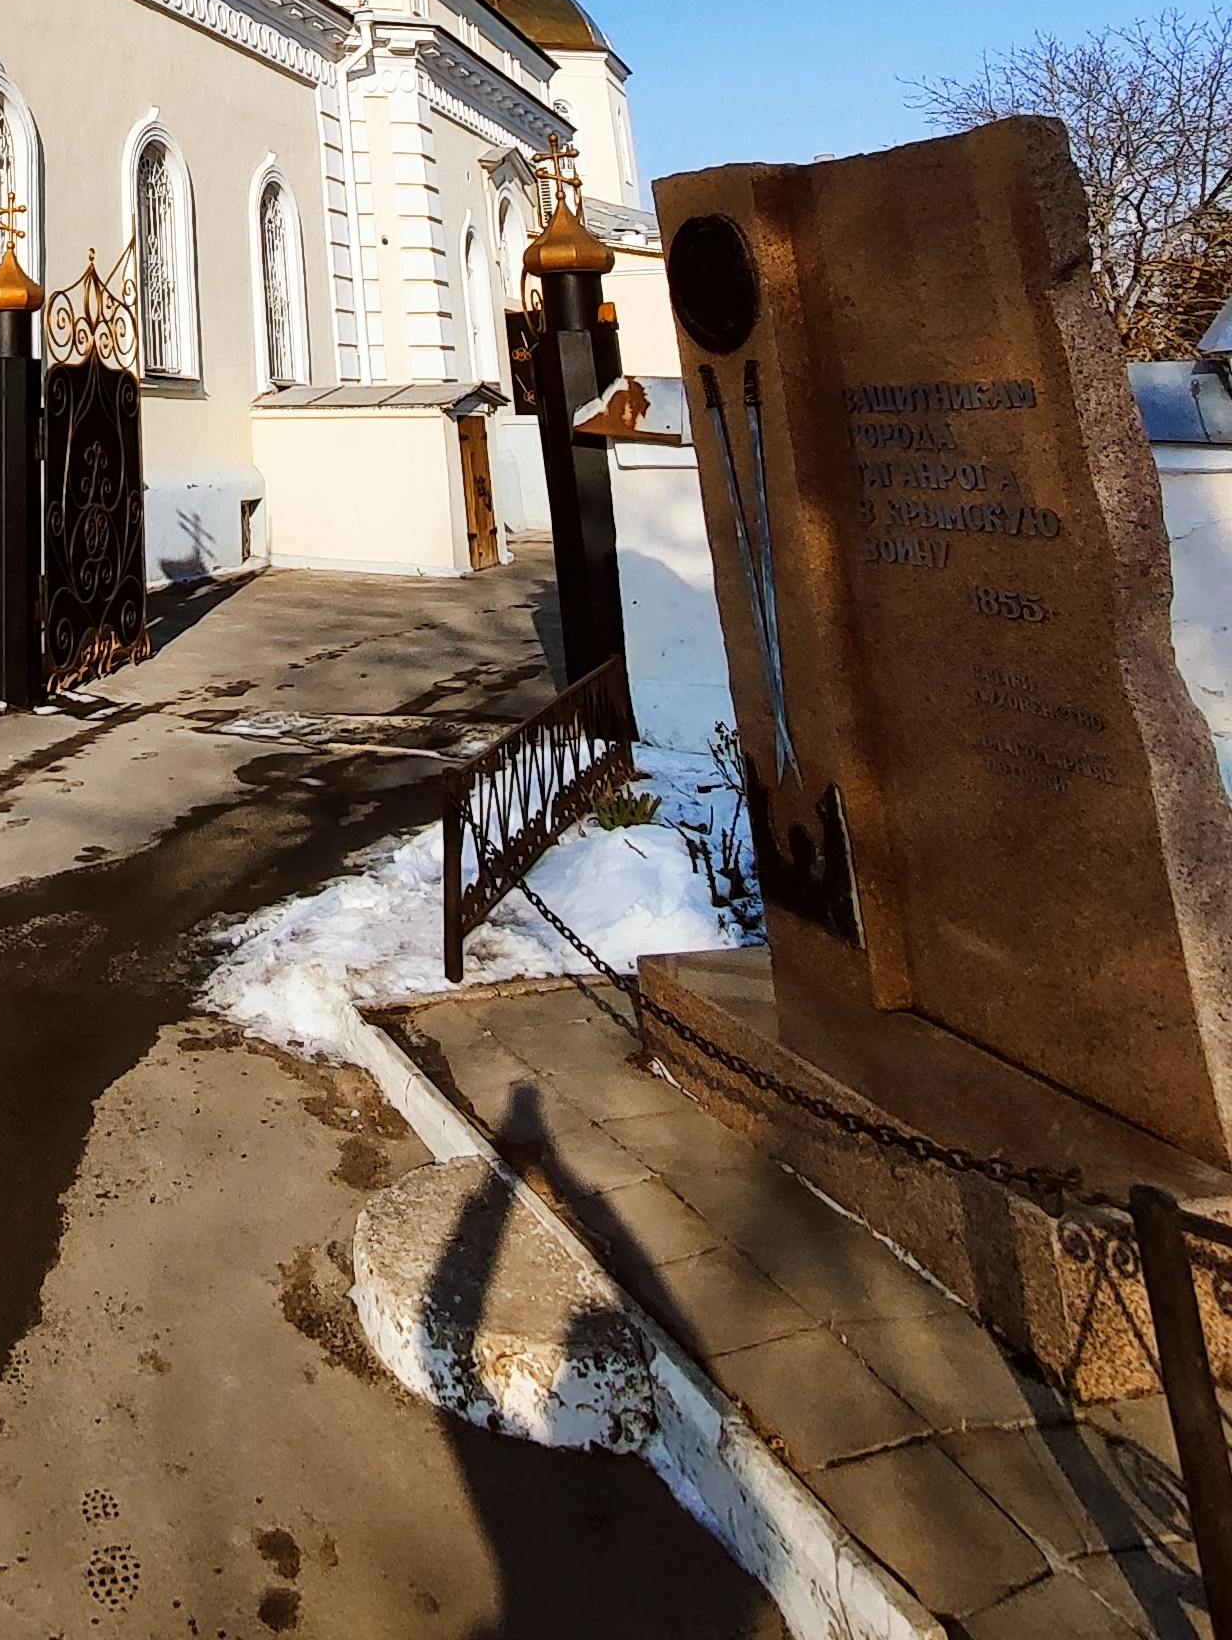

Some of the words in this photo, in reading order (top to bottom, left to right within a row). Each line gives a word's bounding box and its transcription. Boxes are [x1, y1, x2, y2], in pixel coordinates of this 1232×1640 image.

[843, 380, 1036, 413] ЗАЩИТНИКАМ
[846, 422, 957, 451] ГОРОДА
[858, 498, 875, 525] В
[886, 501, 1061, 537] КРЫМСКУЮ
[974, 587, 1045, 622] 1855
